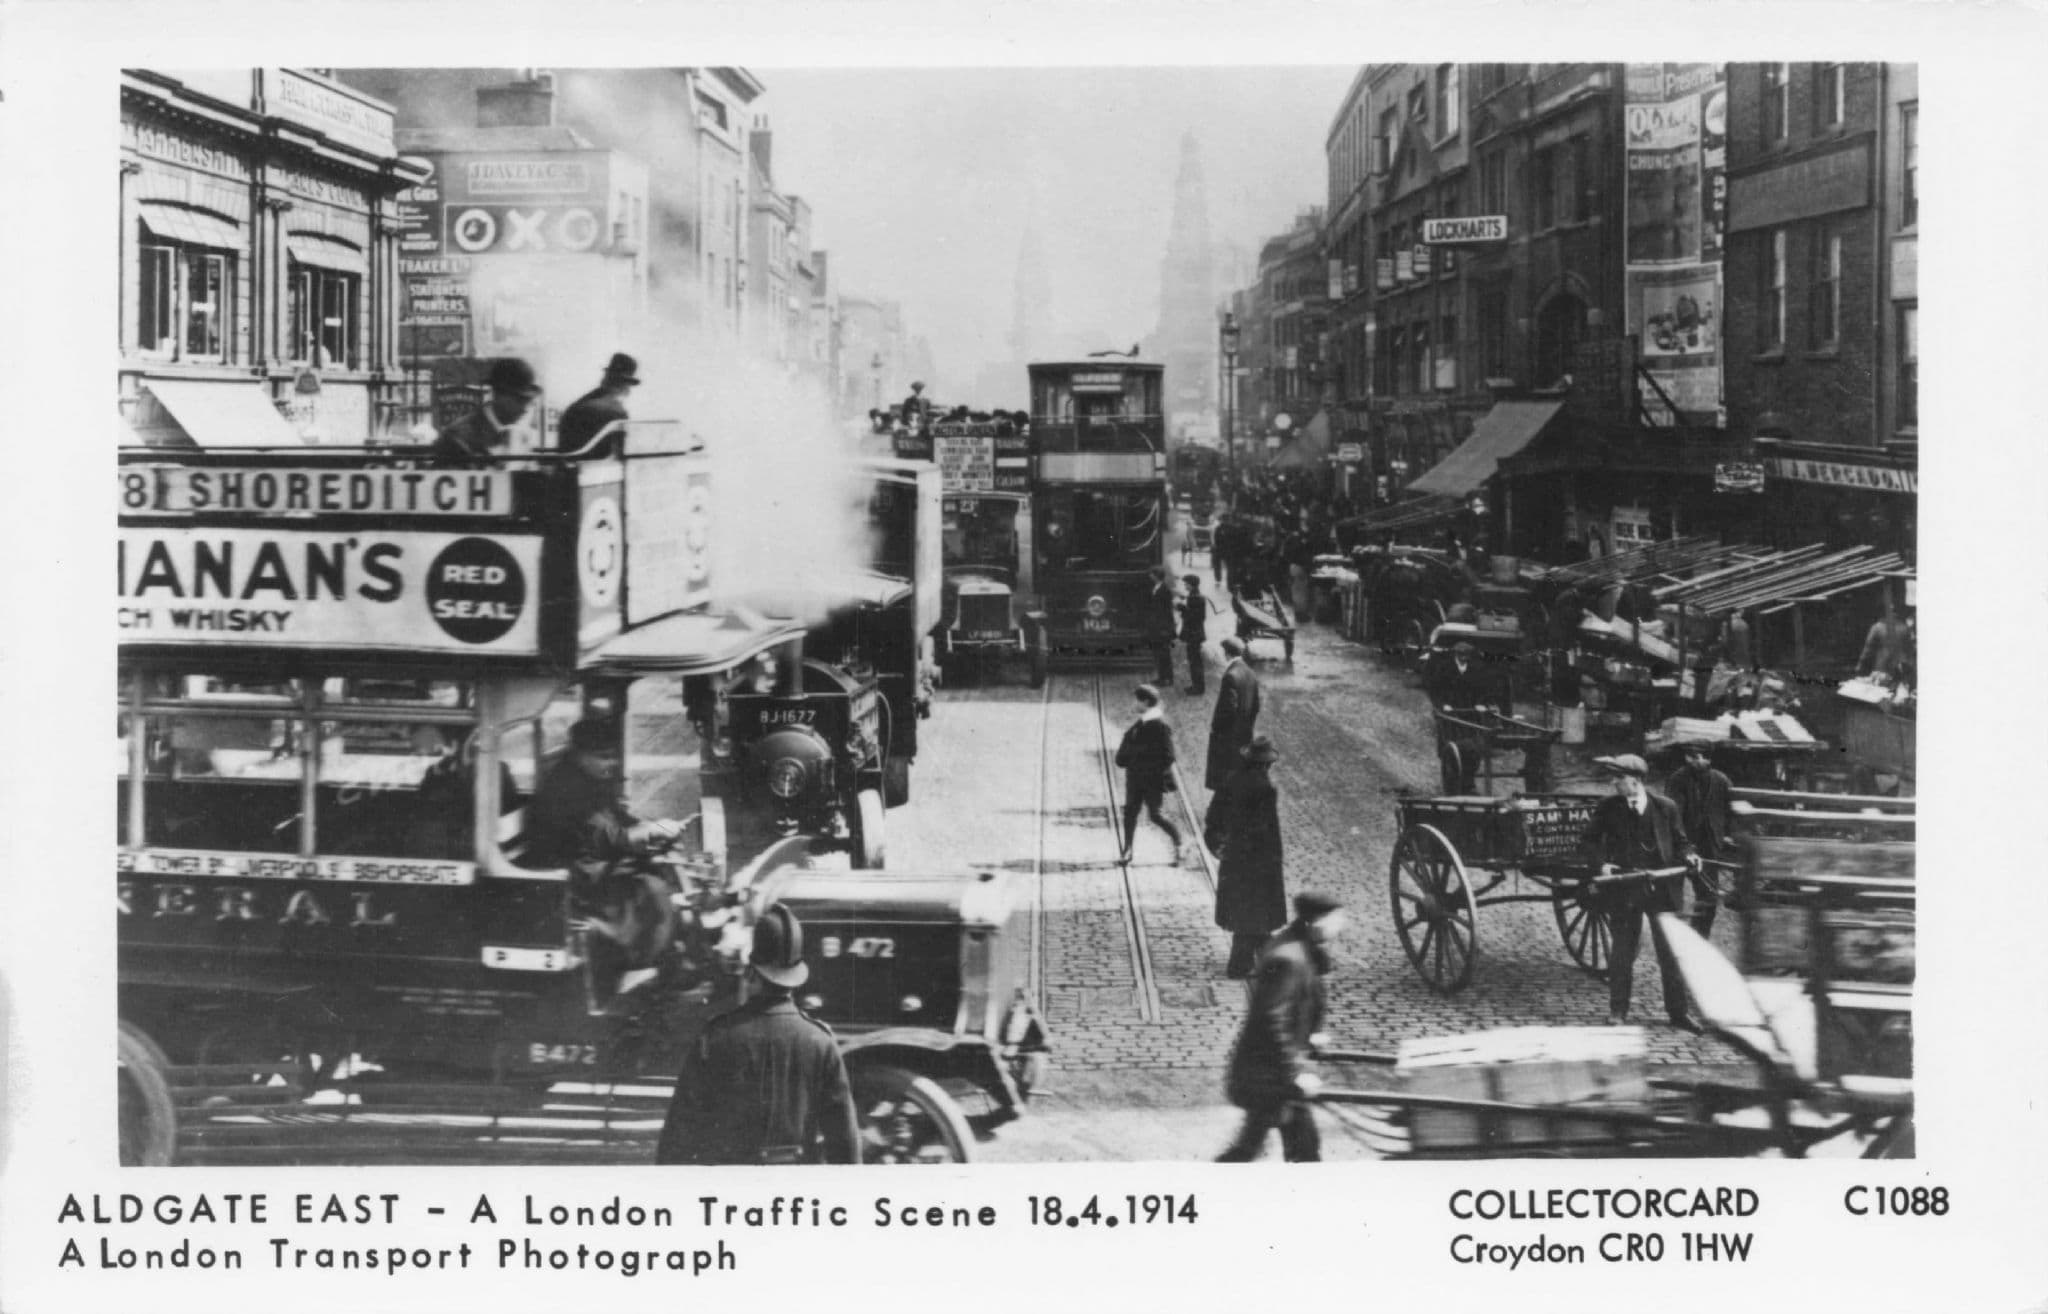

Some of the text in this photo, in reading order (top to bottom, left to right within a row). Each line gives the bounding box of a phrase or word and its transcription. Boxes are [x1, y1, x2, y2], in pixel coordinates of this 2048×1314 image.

[455, 207, 598, 252] OXO
[1428, 219, 1503, 241] LOCKHARTS
[118, 472, 148, 508] 8
[188, 471, 494, 512] SHOREDITCH
[118, 537, 404, 604] ANAN'S
[443, 564, 506, 585] RED
[171, 607, 292, 632] WHISKY
[434, 599, 515, 621] SEAL
[1568, 808, 1596, 823] HA
[352, 863, 459, 886] BISHOPSGATE
[849, 937, 896, 959] 472
